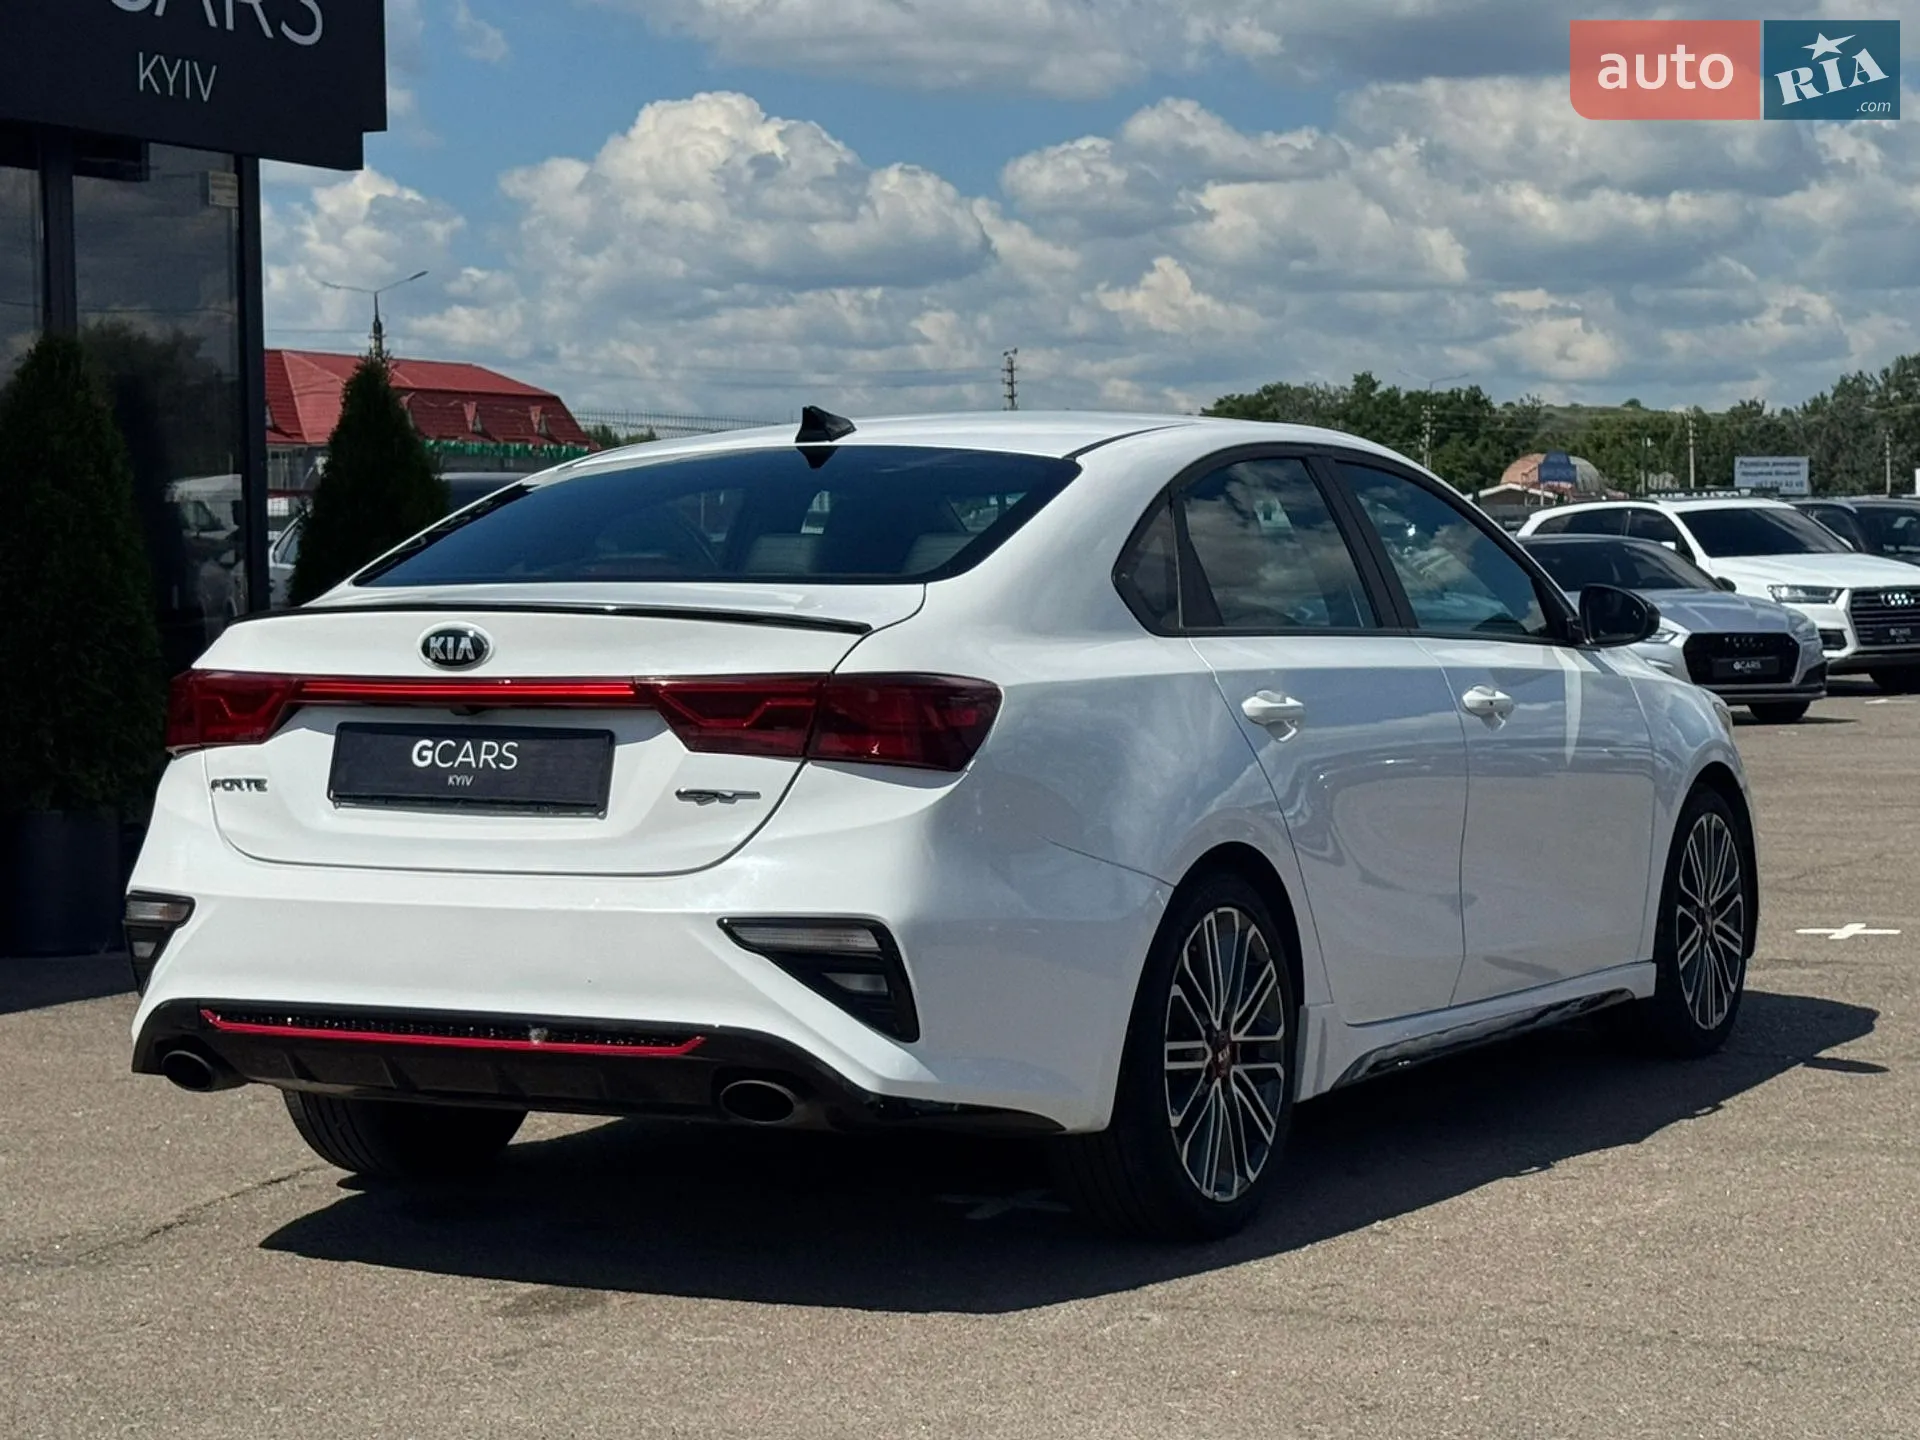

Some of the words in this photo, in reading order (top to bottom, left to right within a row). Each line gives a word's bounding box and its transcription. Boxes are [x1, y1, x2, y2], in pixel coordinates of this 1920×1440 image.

[138, 51, 217, 102] KYIV
[429, 636, 476, 660] KIA
[411, 739, 519, 771] GCARS
[210, 778, 268, 792] FORTE
[447, 774, 475, 787] KYIV
